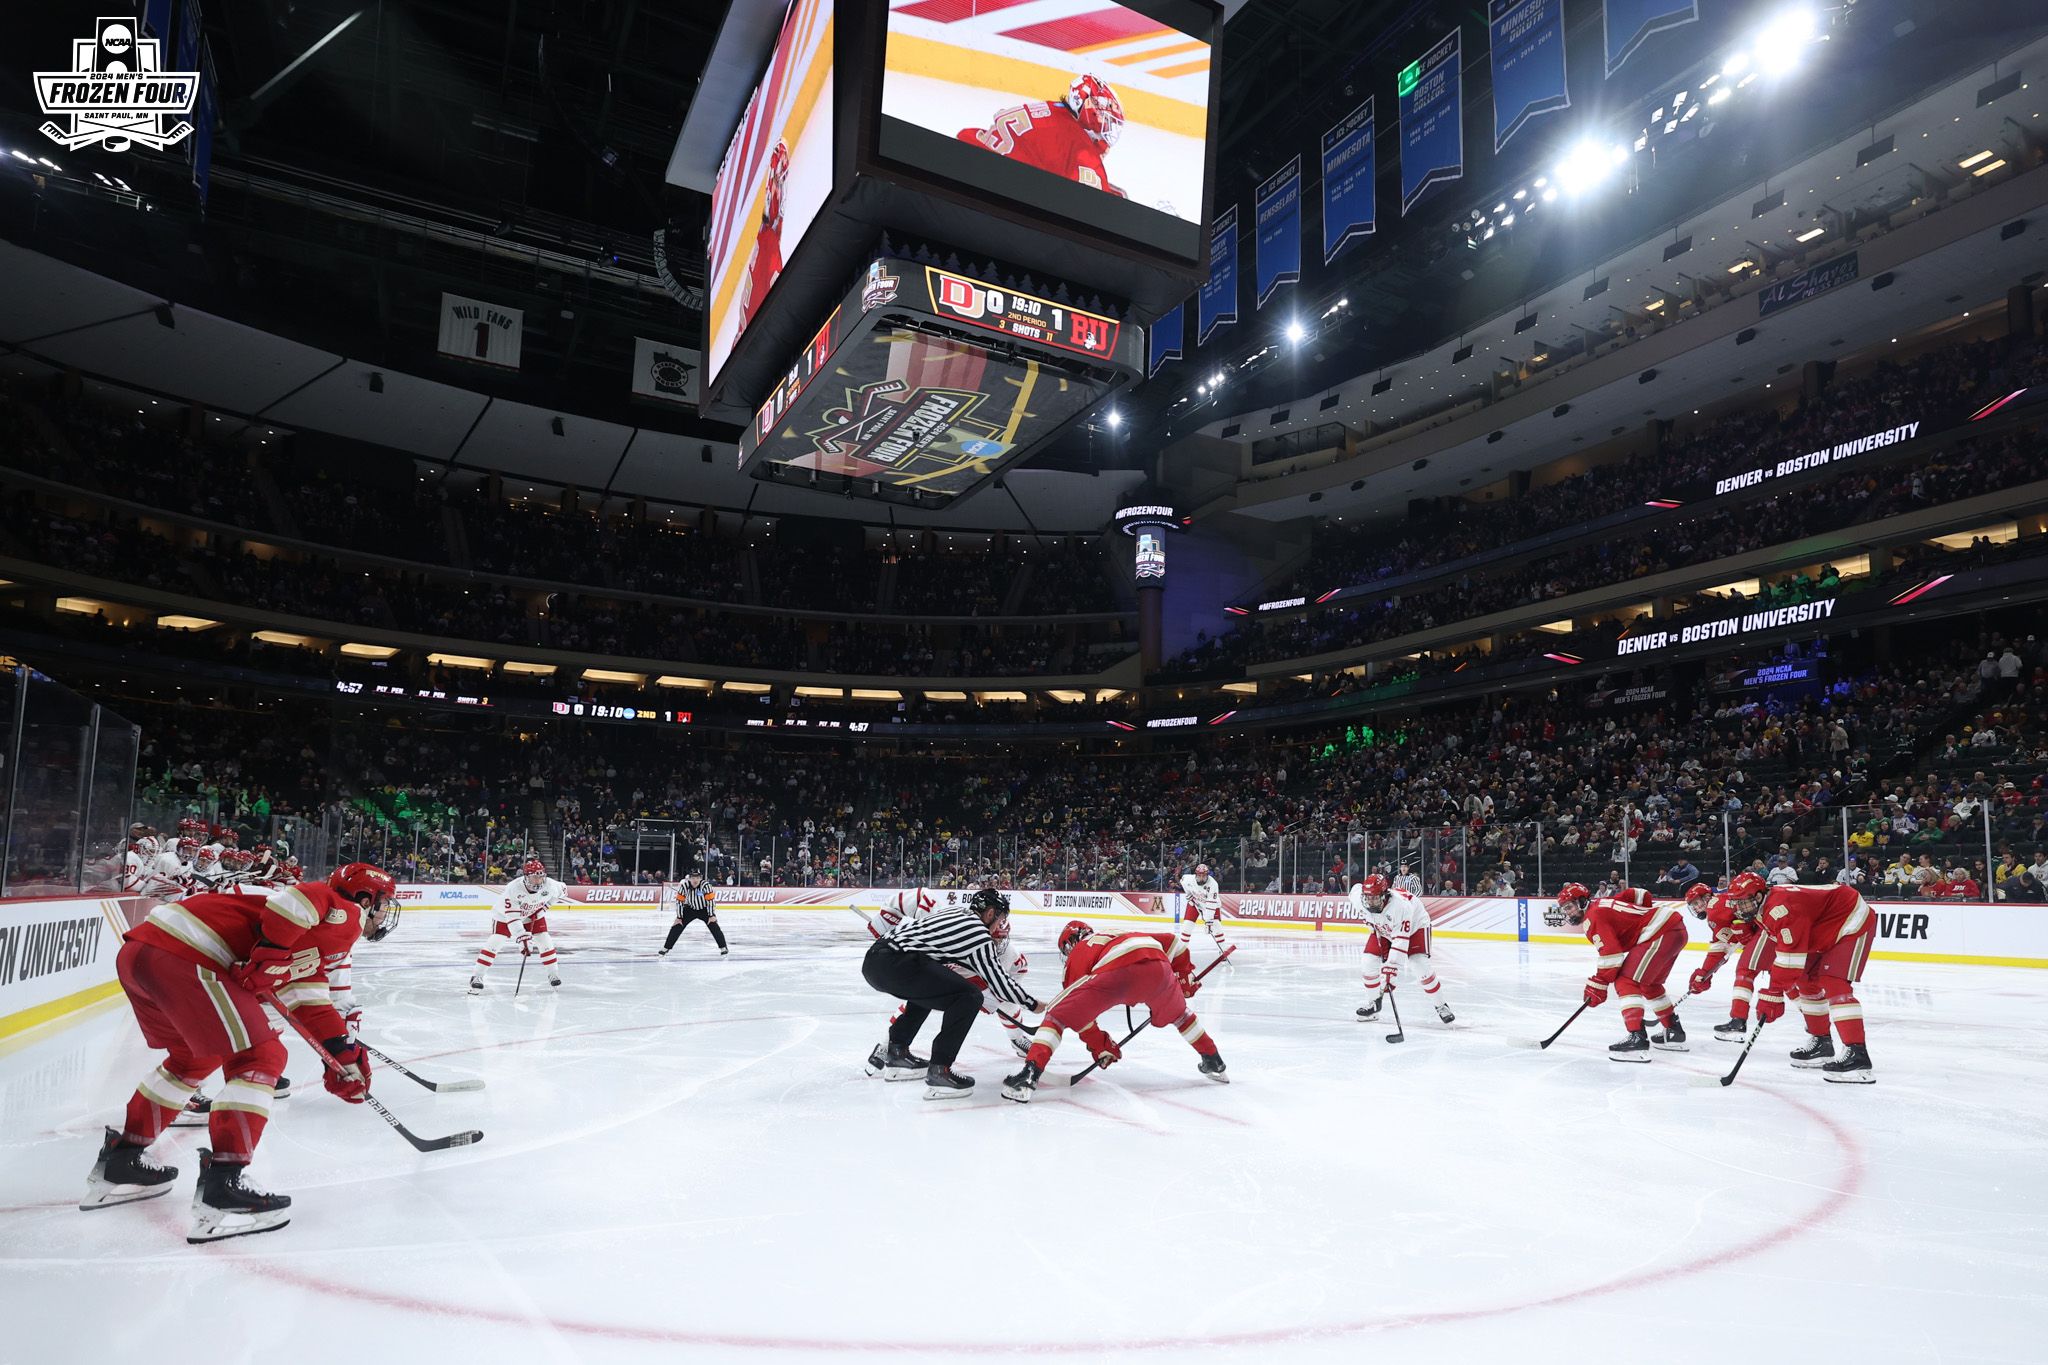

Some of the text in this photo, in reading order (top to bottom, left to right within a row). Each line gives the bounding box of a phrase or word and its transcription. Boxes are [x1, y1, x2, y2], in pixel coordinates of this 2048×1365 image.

[1501, 0, 1547, 36] MINNESO
[1427, 40, 1453, 67] HOCKEY
[1414, 70, 1445, 101] BOSTON
[1413, 82, 1446, 113] COLLEGE
[1327, 131, 1371, 174] MINNESOTA
[1260, 188, 1297, 224] RENSSELAER
[452, 305, 513, 330] WILD FANS
[986, 290, 1004, 315] 0
[1011, 296, 1042, 316] 19:10
[1051, 308, 1063, 331] 1
[1070, 312, 1109, 351] BU
[998, 319, 1006, 329] 3
[1012, 323, 1040, 338] SHOTS
[1007, 311, 1047, 328] 2ND PERIOD
[474, 322, 490, 358] 1
[867, 394, 959, 463] FROZEN FOUR
[1715, 468, 1763, 496] DENVER
[1776, 448, 1830, 478] BOSTON
[1832, 421, 1920, 461] UNIVERSITY
[1115, 506, 1173, 520] #MFROZENFOUR
[1258, 597, 1306, 612] #MFROZENFOUR
[1617, 631, 1667, 656] DENVER
[1681, 617, 1739, 644] BOSTON
[1742, 598, 1836, 633] UNIVERSITY
[1743, 669, 1808, 686] MEN'S FROZEN FOUR
[1757, 664, 1793, 676] 2024 NCAA
[481, 697, 489, 705] 3
[573, 704, 584, 716] 0
[591, 705, 624, 718] 19:10
[637, 710, 656, 719] 2ND
[664, 711, 672, 722] 1
[1147, 716, 1198, 728] #MFROZENFOUR
[396, 890, 423, 900] ESPN
[440, 891, 479, 900] NCAA.com
[505, 898, 511, 909] 5
[586, 889, 620, 902] 2024
[623, 889, 655, 902] NCAA
[714, 891, 776, 902] OZEN FOUR
[1055, 896, 1077, 908] BOSTON
[1078, 896, 1113, 909] UNIVERSITY
[1239, 899, 1264, 916] 2024
[1267, 900, 1293, 917] NCAA
[1298, 901, 1333, 919] MEN'S
[1519, 902, 1527, 930] NCAA
[1400, 920, 1411, 932] 18
[1876, 914, 1929, 940] VER
[19, 917, 104, 981] UNIVERSITY
[368, 1049, 408, 1074] BAUER
[368, 1098, 400, 1127] BAUER
